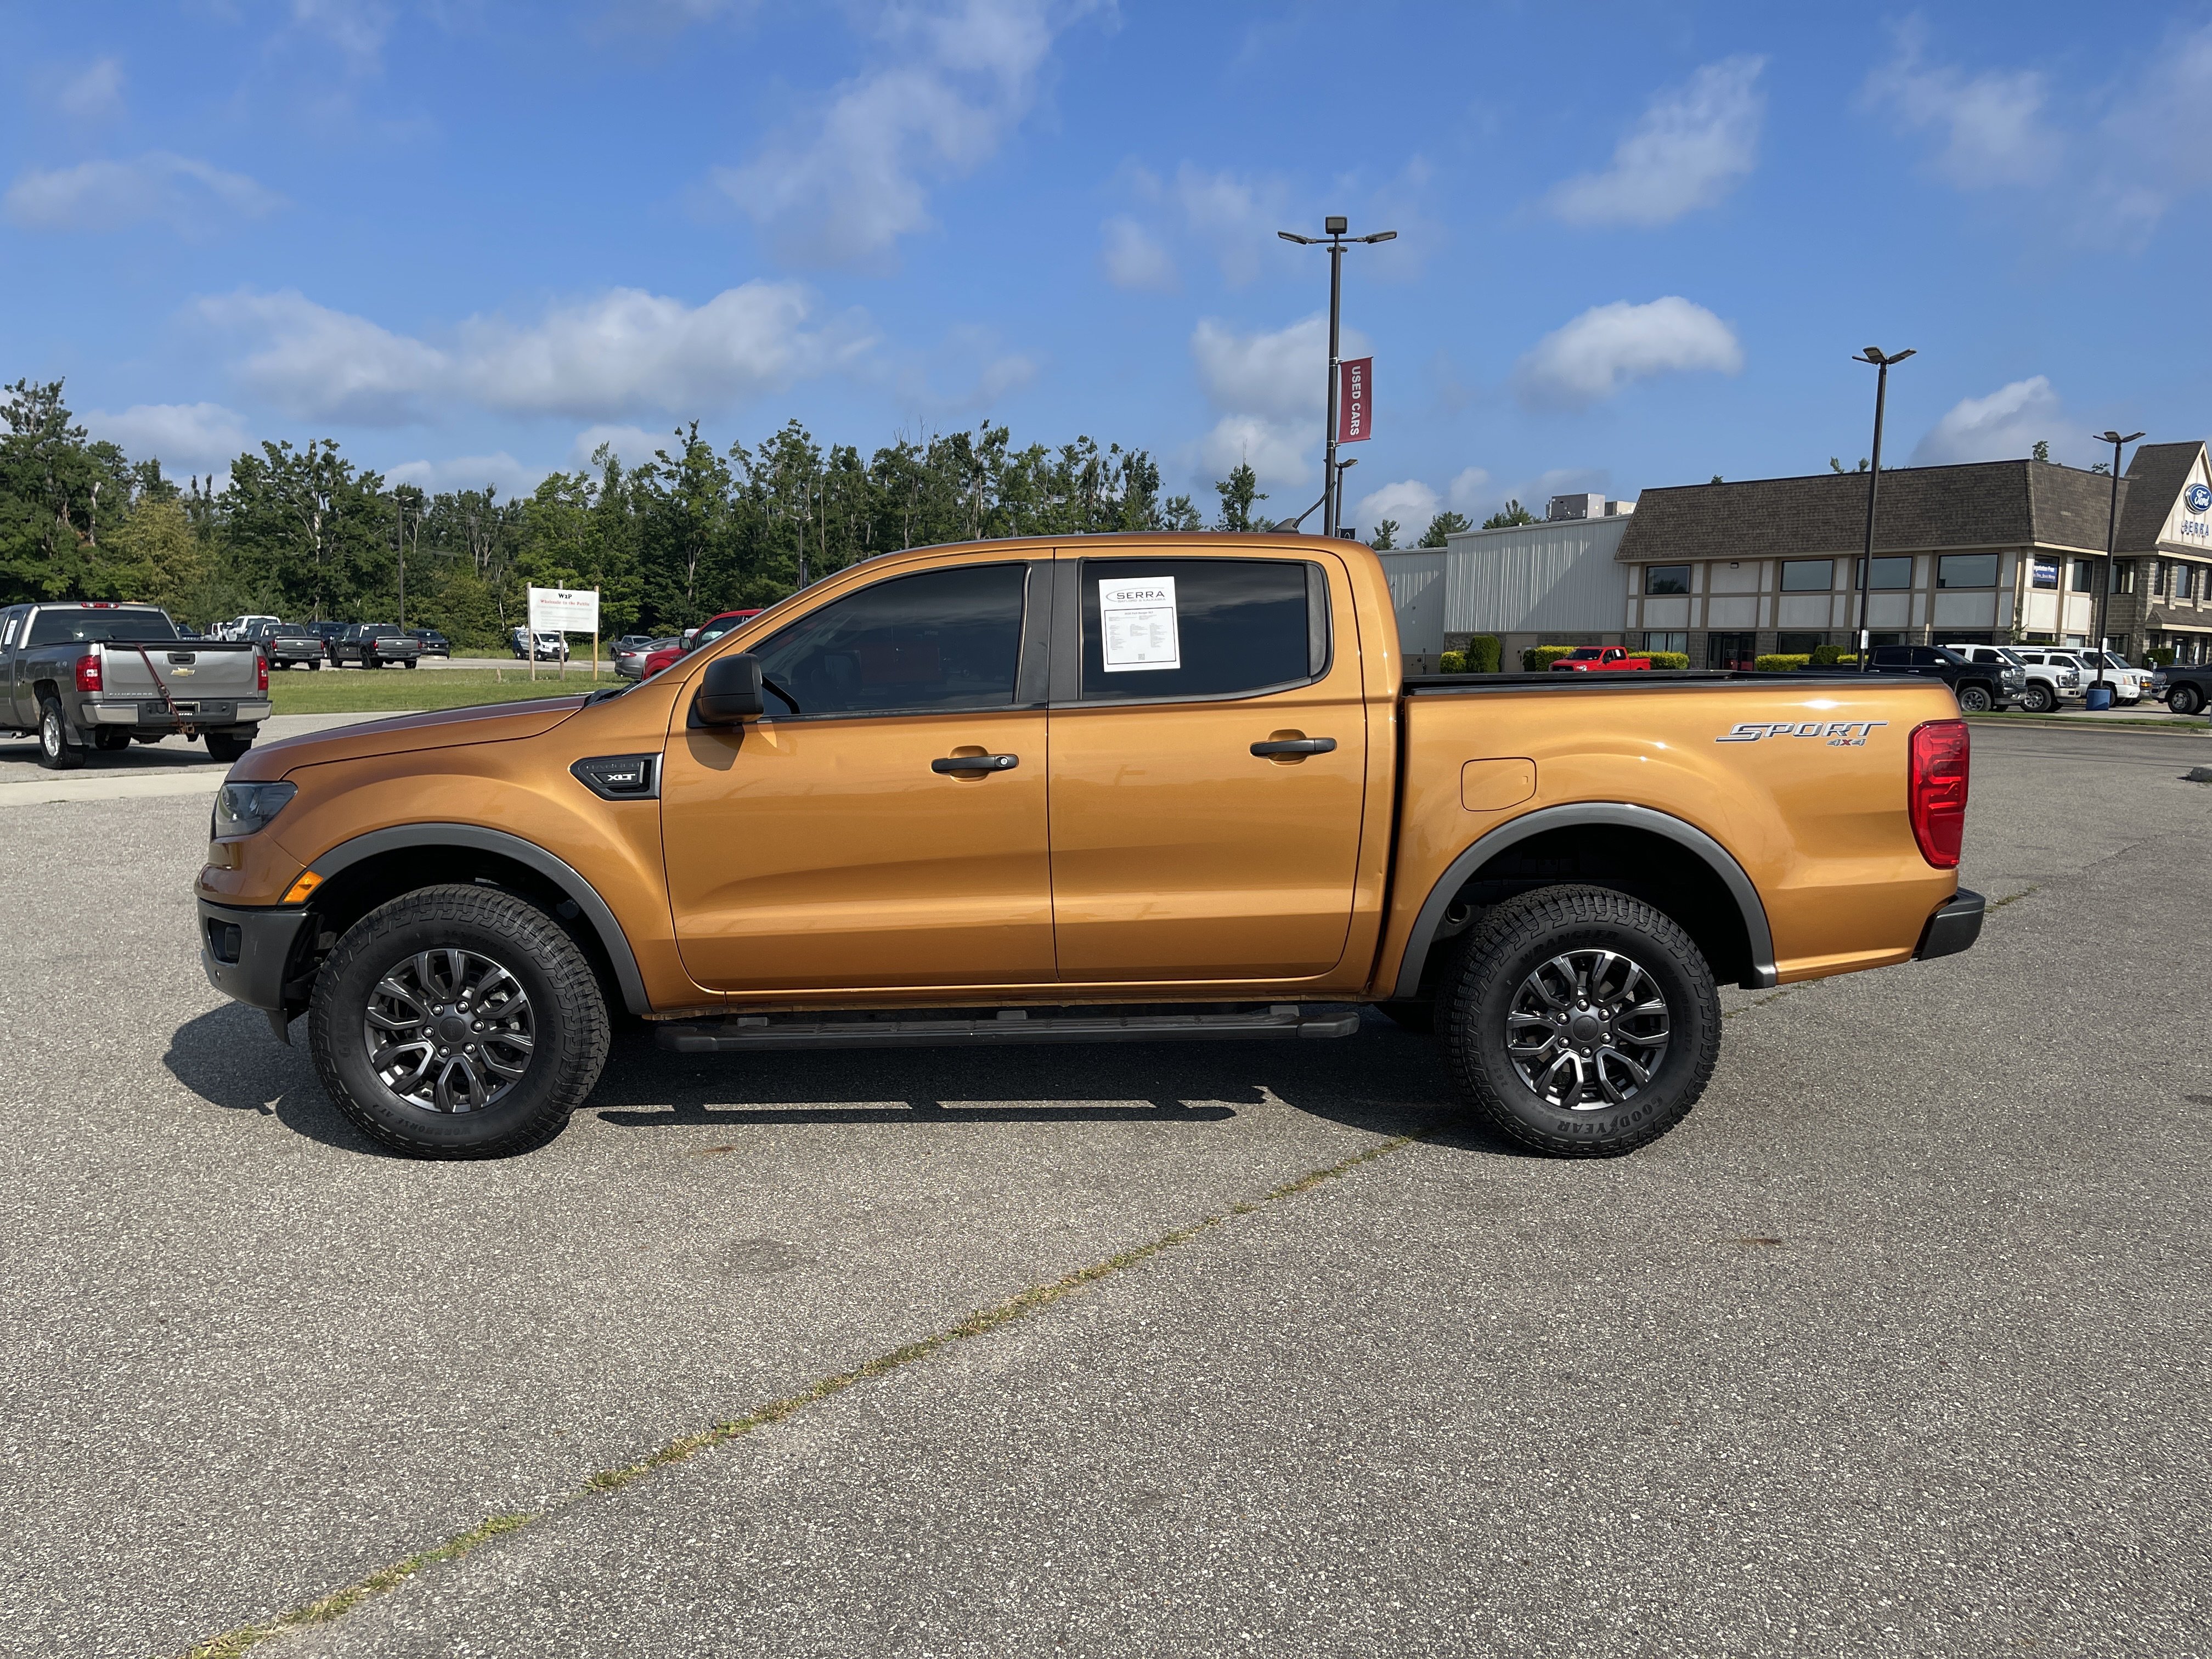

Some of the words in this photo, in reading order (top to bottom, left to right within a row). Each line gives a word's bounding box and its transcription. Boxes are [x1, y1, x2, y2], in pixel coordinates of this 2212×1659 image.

[1351, 365, 1361, 399] USED
[1350, 402, 1361, 436] CARS
[2194, 489, 2210, 506] Ford
[2184, 520, 2209, 536] SERRA
[1116, 591, 1165, 599] SERRA
[1715, 720, 1889, 743] SPORT
[1519, 929, 1620, 966] WRANGLER
[1556, 1096, 1663, 1137] GOODYEAR
